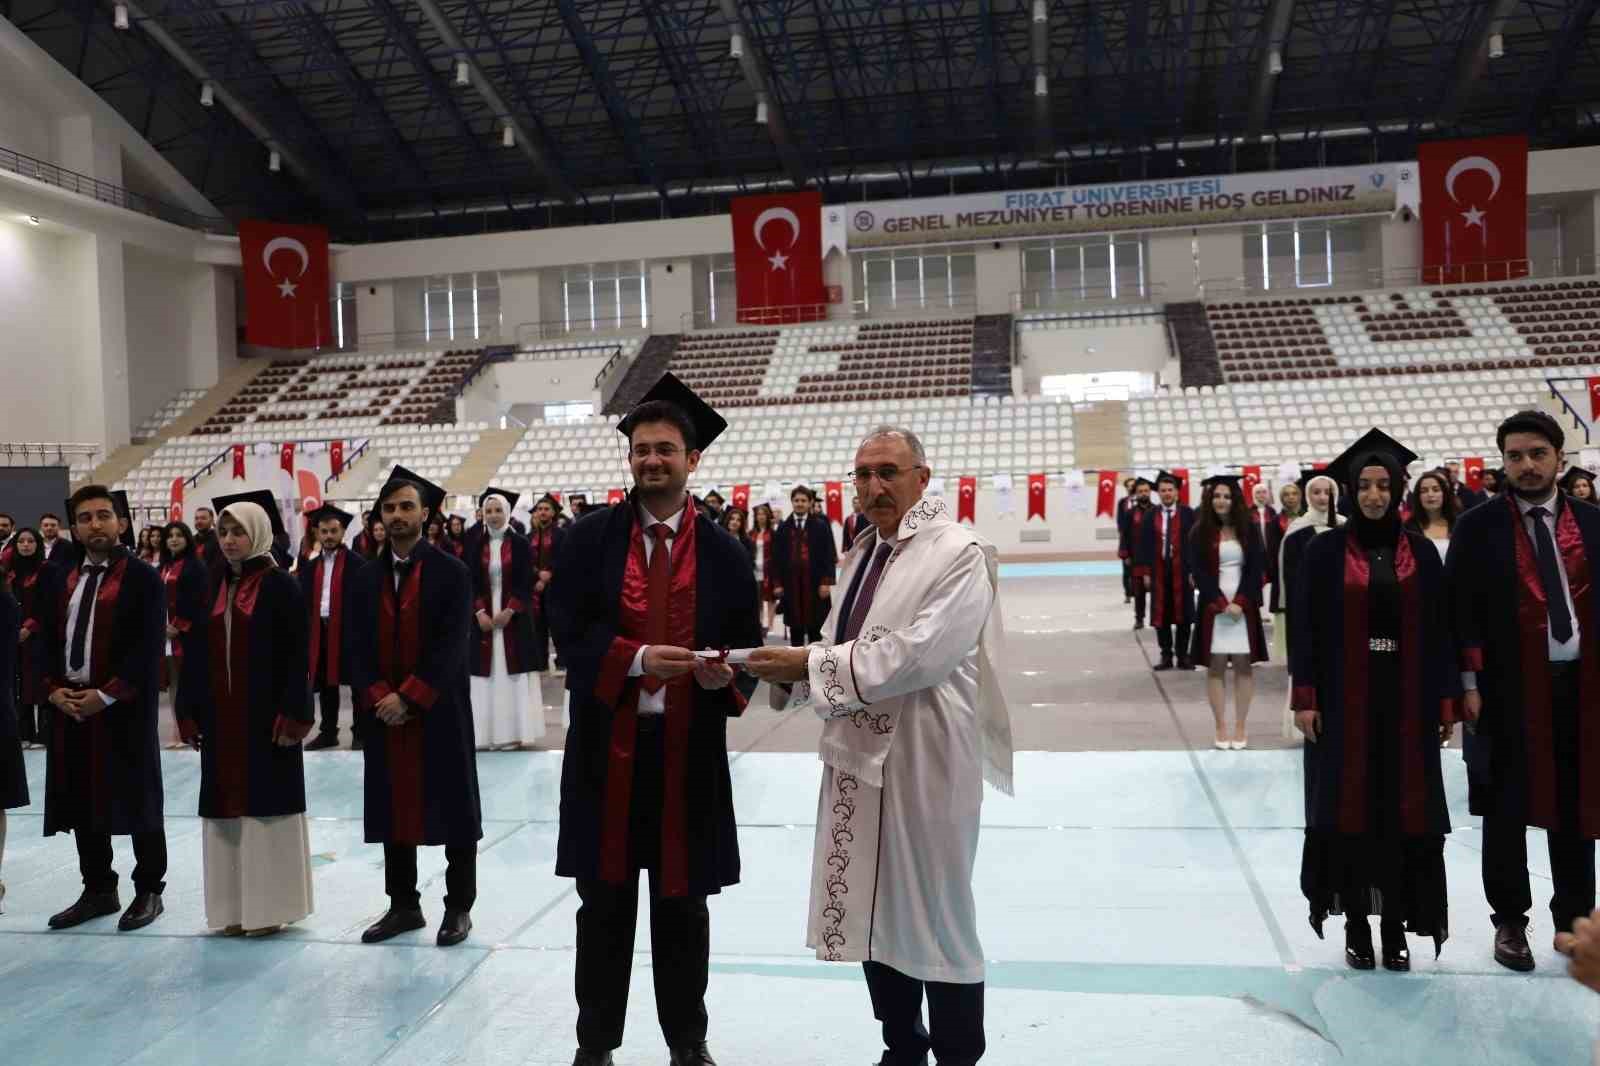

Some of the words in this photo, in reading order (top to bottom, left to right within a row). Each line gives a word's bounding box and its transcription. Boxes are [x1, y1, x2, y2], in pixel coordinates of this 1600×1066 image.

[883, 214, 950, 233] GENEL
[956, 204, 1076, 228] MEZUNİYET
[1200, 192, 1246, 211] HOŞ
[1252, 184, 1356, 207] GELDİNİZ
[1006, 191, 1064, 209] FIRAT
